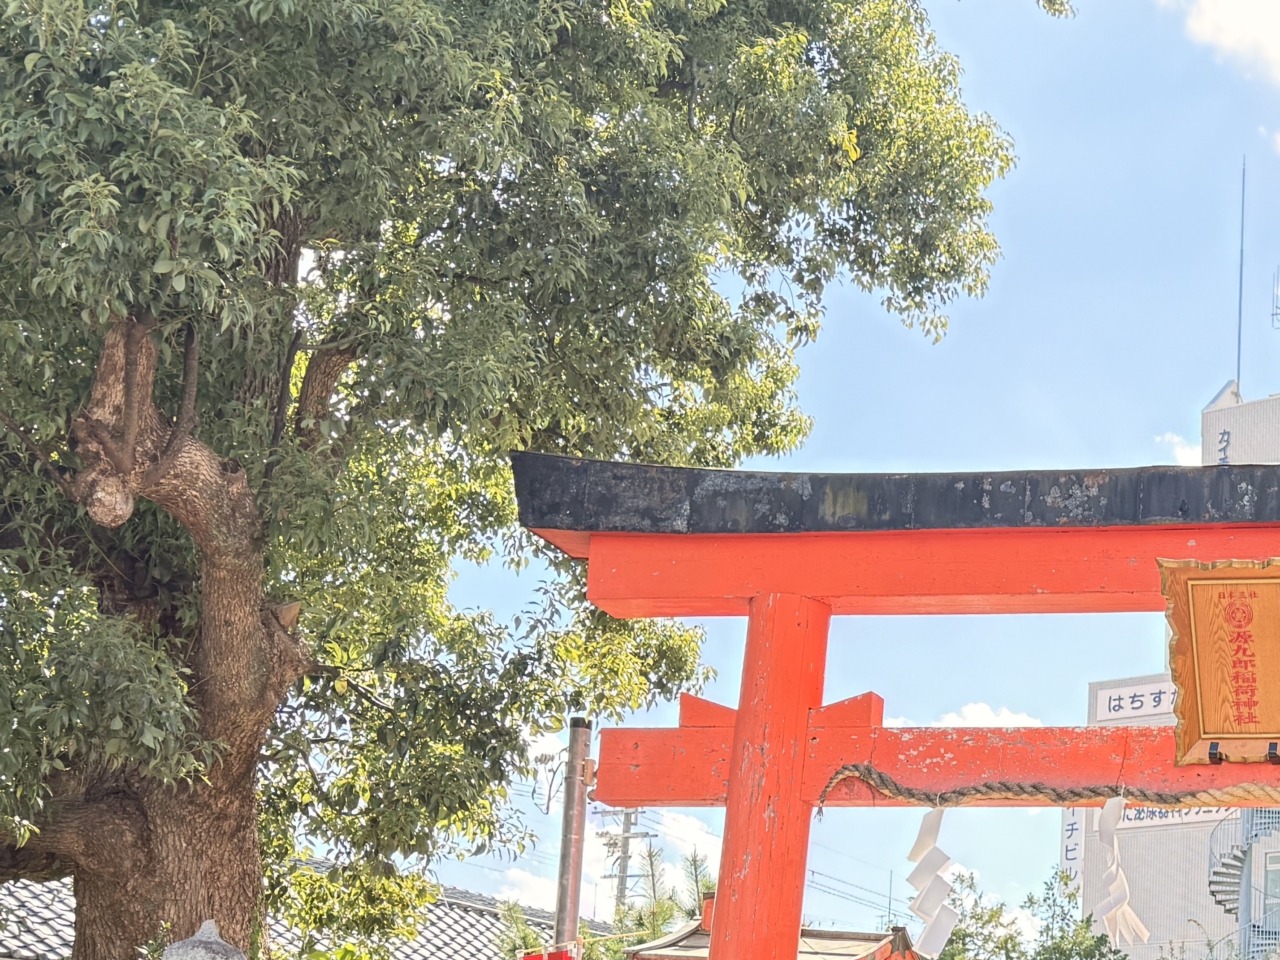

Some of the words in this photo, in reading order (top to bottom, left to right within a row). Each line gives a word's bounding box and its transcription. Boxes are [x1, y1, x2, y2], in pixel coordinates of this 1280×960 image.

[1229, 631, 1260, 726] 源九郎稲荷神社
